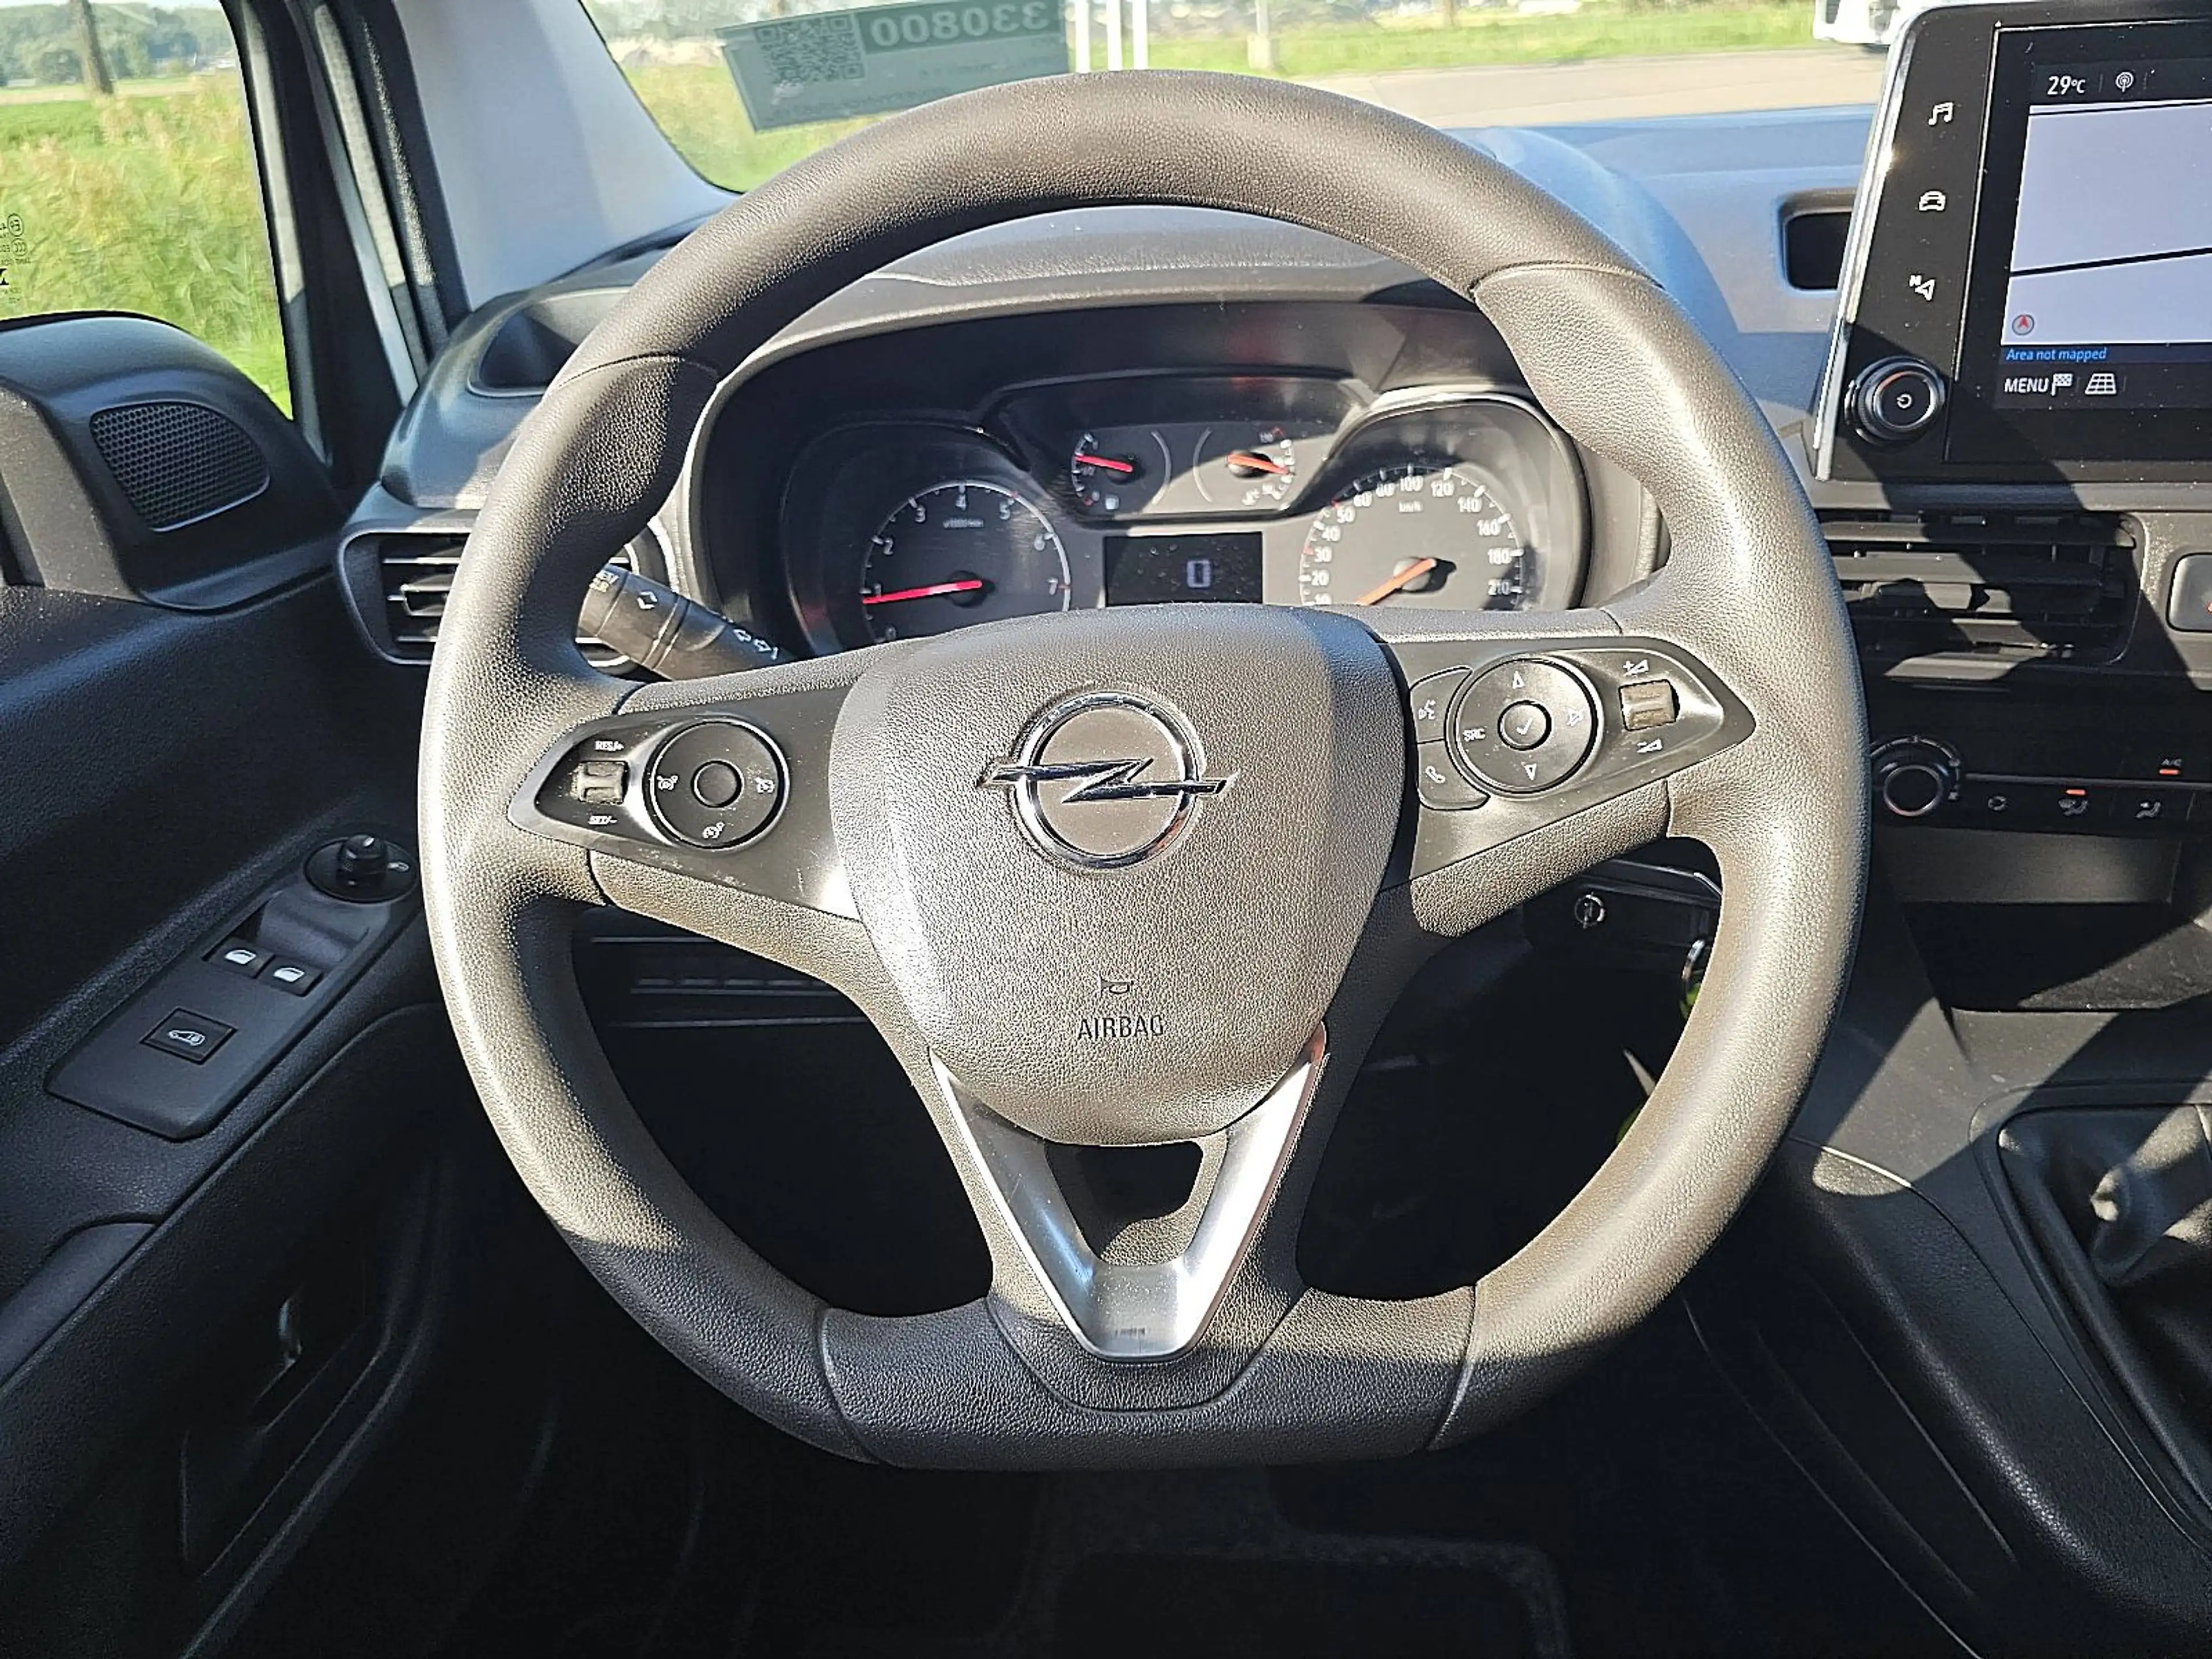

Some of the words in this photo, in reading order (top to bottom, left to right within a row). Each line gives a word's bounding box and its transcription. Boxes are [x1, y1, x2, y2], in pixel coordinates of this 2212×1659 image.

[2006, 348, 2033, 361] Area
[2036, 349, 2056, 361] not
[2058, 347, 2107, 362] mapped
[2004, 378, 2049, 393] MENU
[1400, 475, 1423, 491] 100
[1431, 481, 1455, 497] 120
[999, 501, 1011, 520] 5
[1457, 497, 1482, 513] 140
[915, 505, 926, 522] 3
[1321, 525, 1341, 541] 40
[883, 537, 893, 555] 2
[1314, 546, 1332, 562] 30
[1311, 570, 1330, 586] 20
[1048, 578, 1058, 596] 7
[1078, 1015, 1164, 1040] AIRBAG
